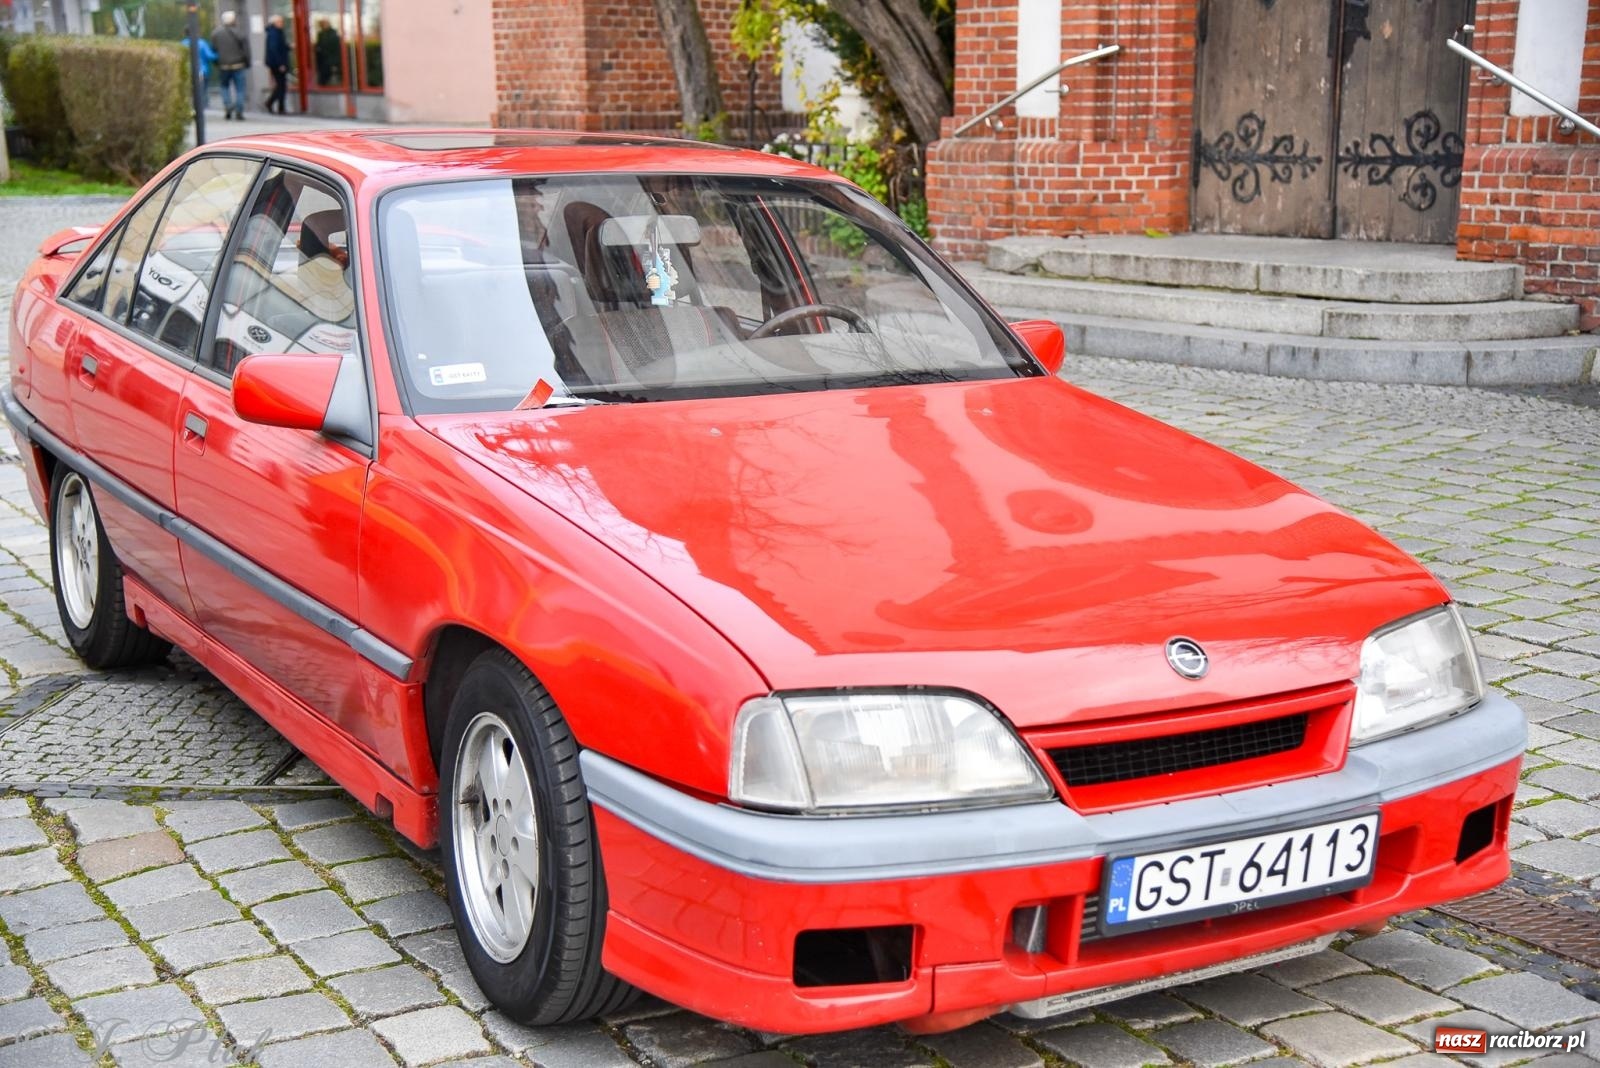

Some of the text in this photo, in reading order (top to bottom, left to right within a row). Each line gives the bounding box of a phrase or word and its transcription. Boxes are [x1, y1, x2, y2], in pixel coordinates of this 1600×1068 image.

[1135, 823, 1370, 912] GST 64113
[1108, 898, 1127, 914] PL
